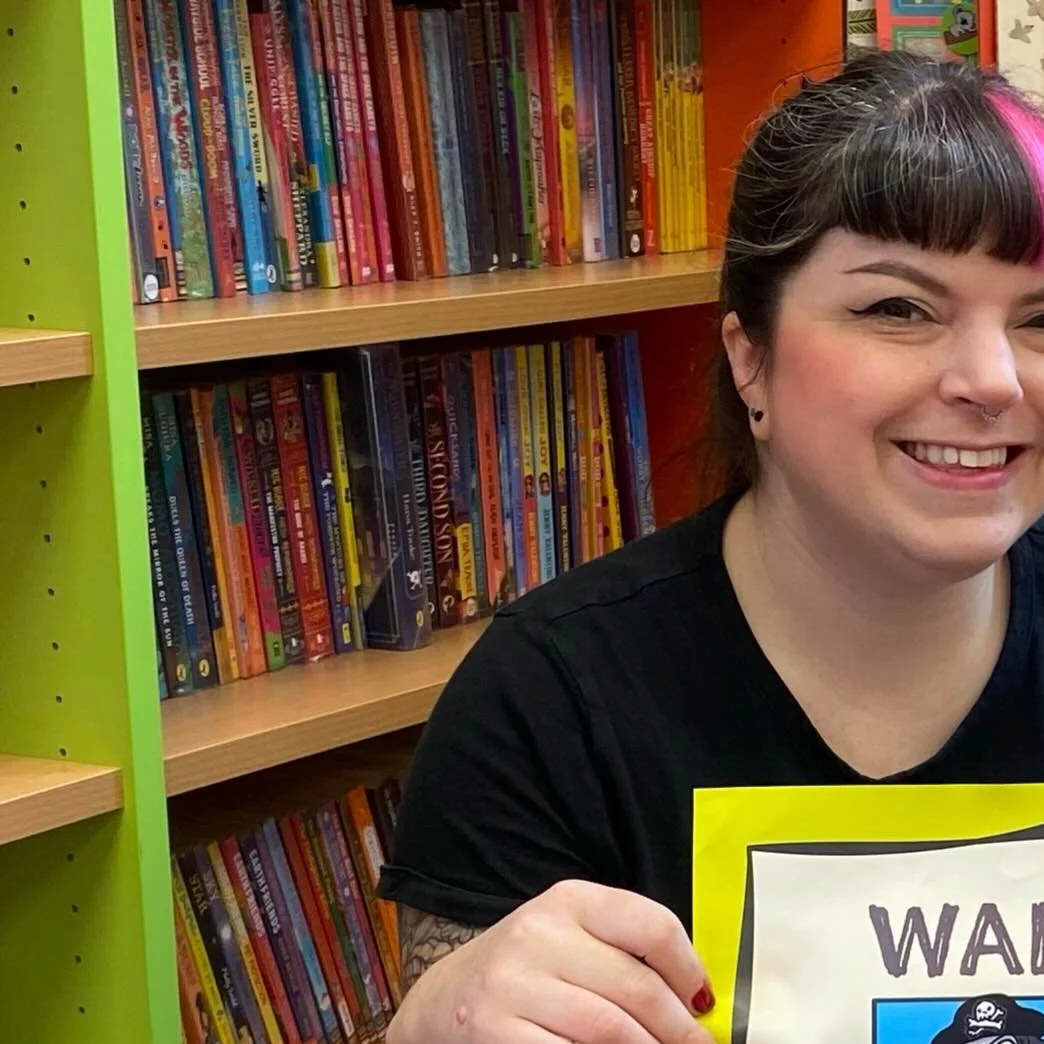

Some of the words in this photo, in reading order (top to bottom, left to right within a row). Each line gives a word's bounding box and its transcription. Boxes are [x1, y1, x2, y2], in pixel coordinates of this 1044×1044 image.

[243, 65, 251, 84] THE
[247, 89, 257, 129] SILVER
[252, 132, 263, 173] SWORD
[291, 180, 307, 265] SHEPPARD
[413, 456, 425, 503] THIRD
[427, 440, 449, 520] SECOND
[174, 527, 182, 546] THE
[437, 522, 454, 563] SON
[152, 549, 164, 586] MIRROR
[176, 546, 187, 578] QUEEN
[161, 606, 170, 625] THE
[183, 594, 194, 625] DEATH
[164, 628, 173, 647] SUN
